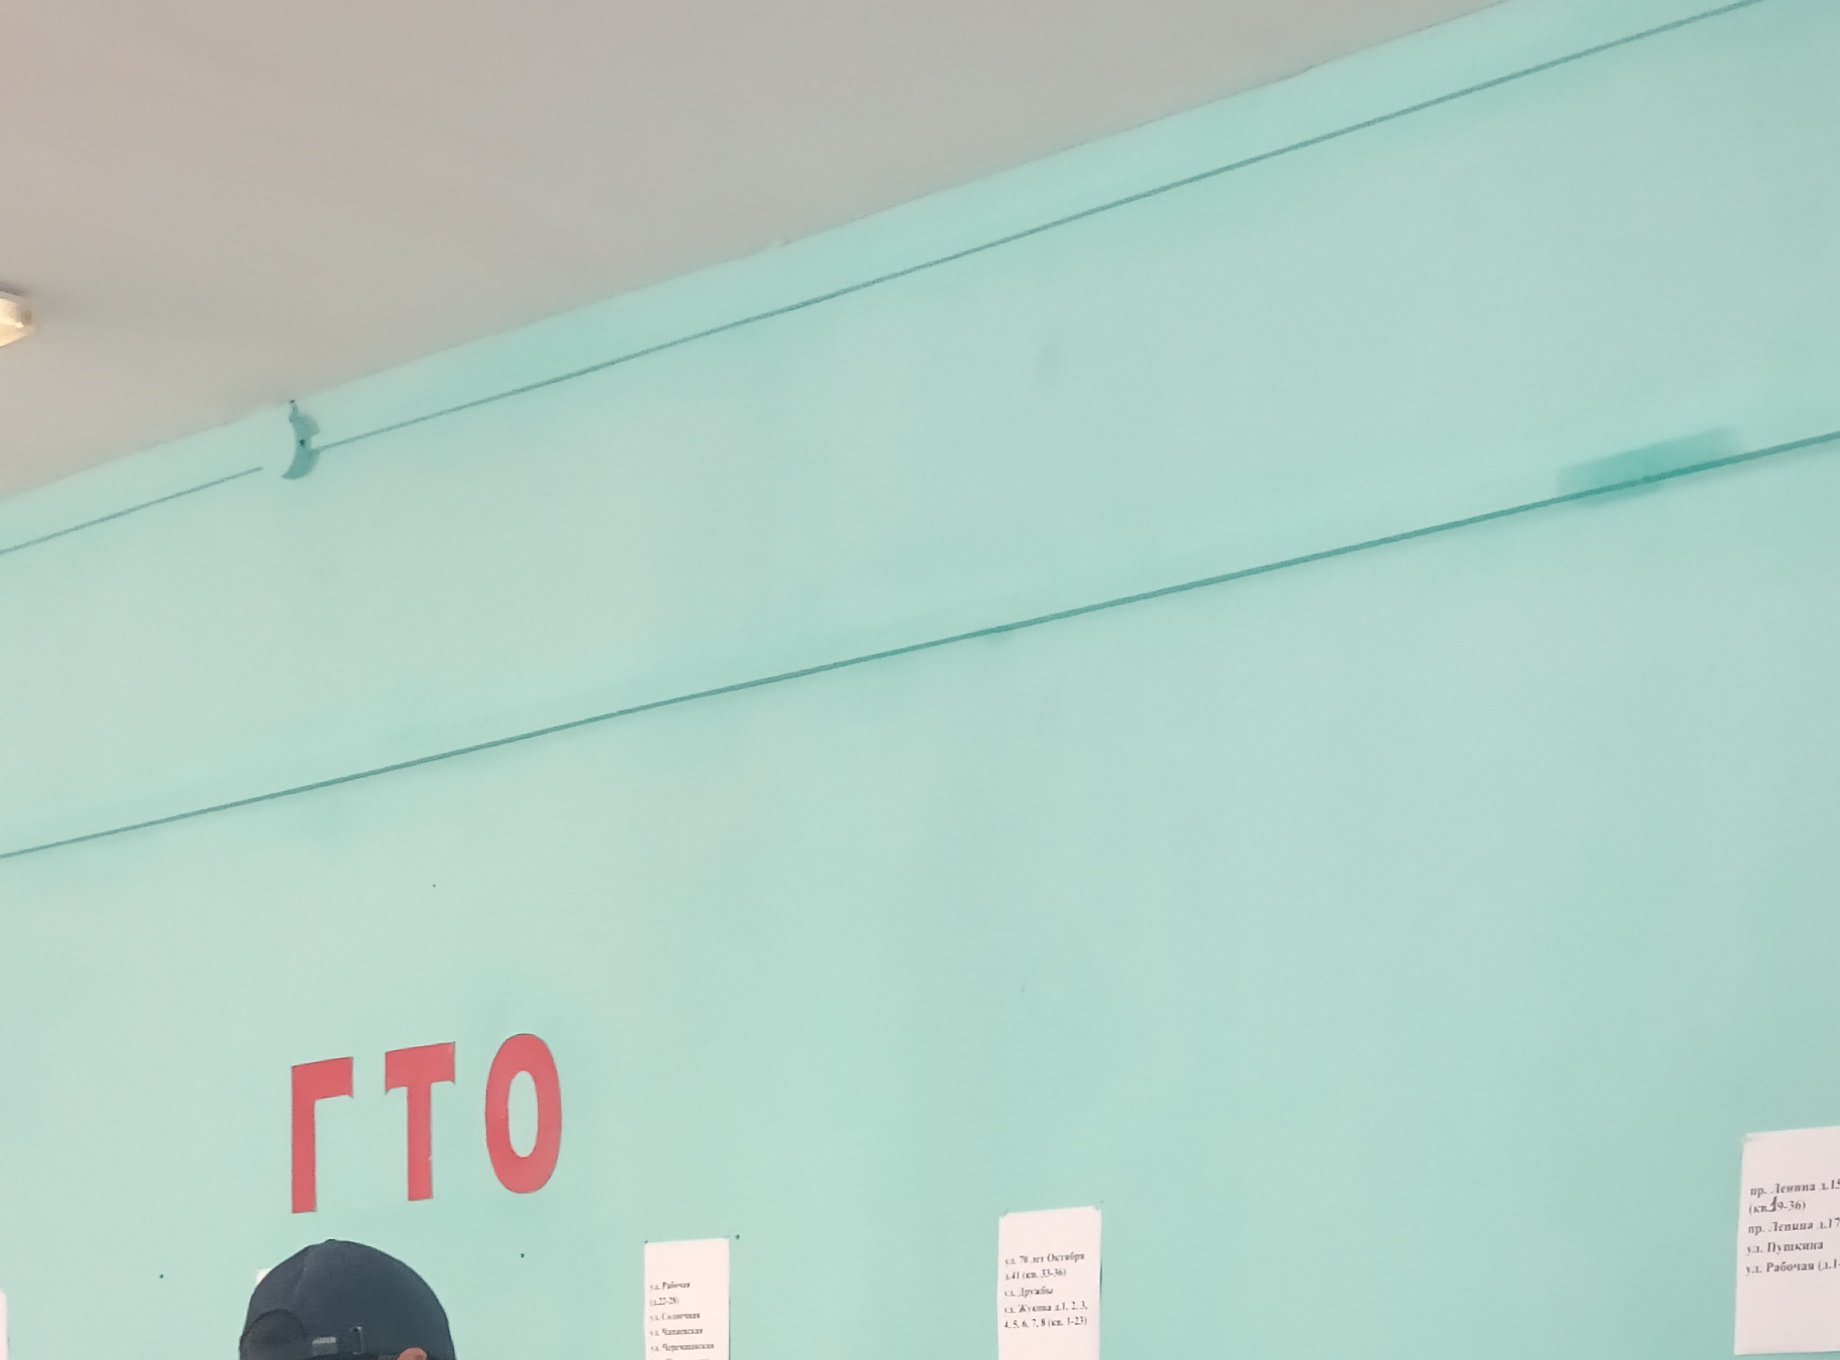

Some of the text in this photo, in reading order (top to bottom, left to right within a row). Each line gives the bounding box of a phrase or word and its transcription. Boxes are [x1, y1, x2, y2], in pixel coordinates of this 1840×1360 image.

[291, 1033, 562, 1214] ГТО
[1750, 1187, 1767, 1198] пр.
[1770, 1183, 1816, 1194] Ленина
[1748, 1225, 1765, 1236] пр.
[1767, 1221, 1814, 1233] Ленина
[1746, 1241, 1824, 1256] ул. Пушкина
[1047, 1252, 1085, 1263] Октября
[1745, 1265, 1762, 1277] ул.
[1766, 1261, 1815, 1273] Рабочая
[1018, 1286, 1054, 1298] Дружбы
